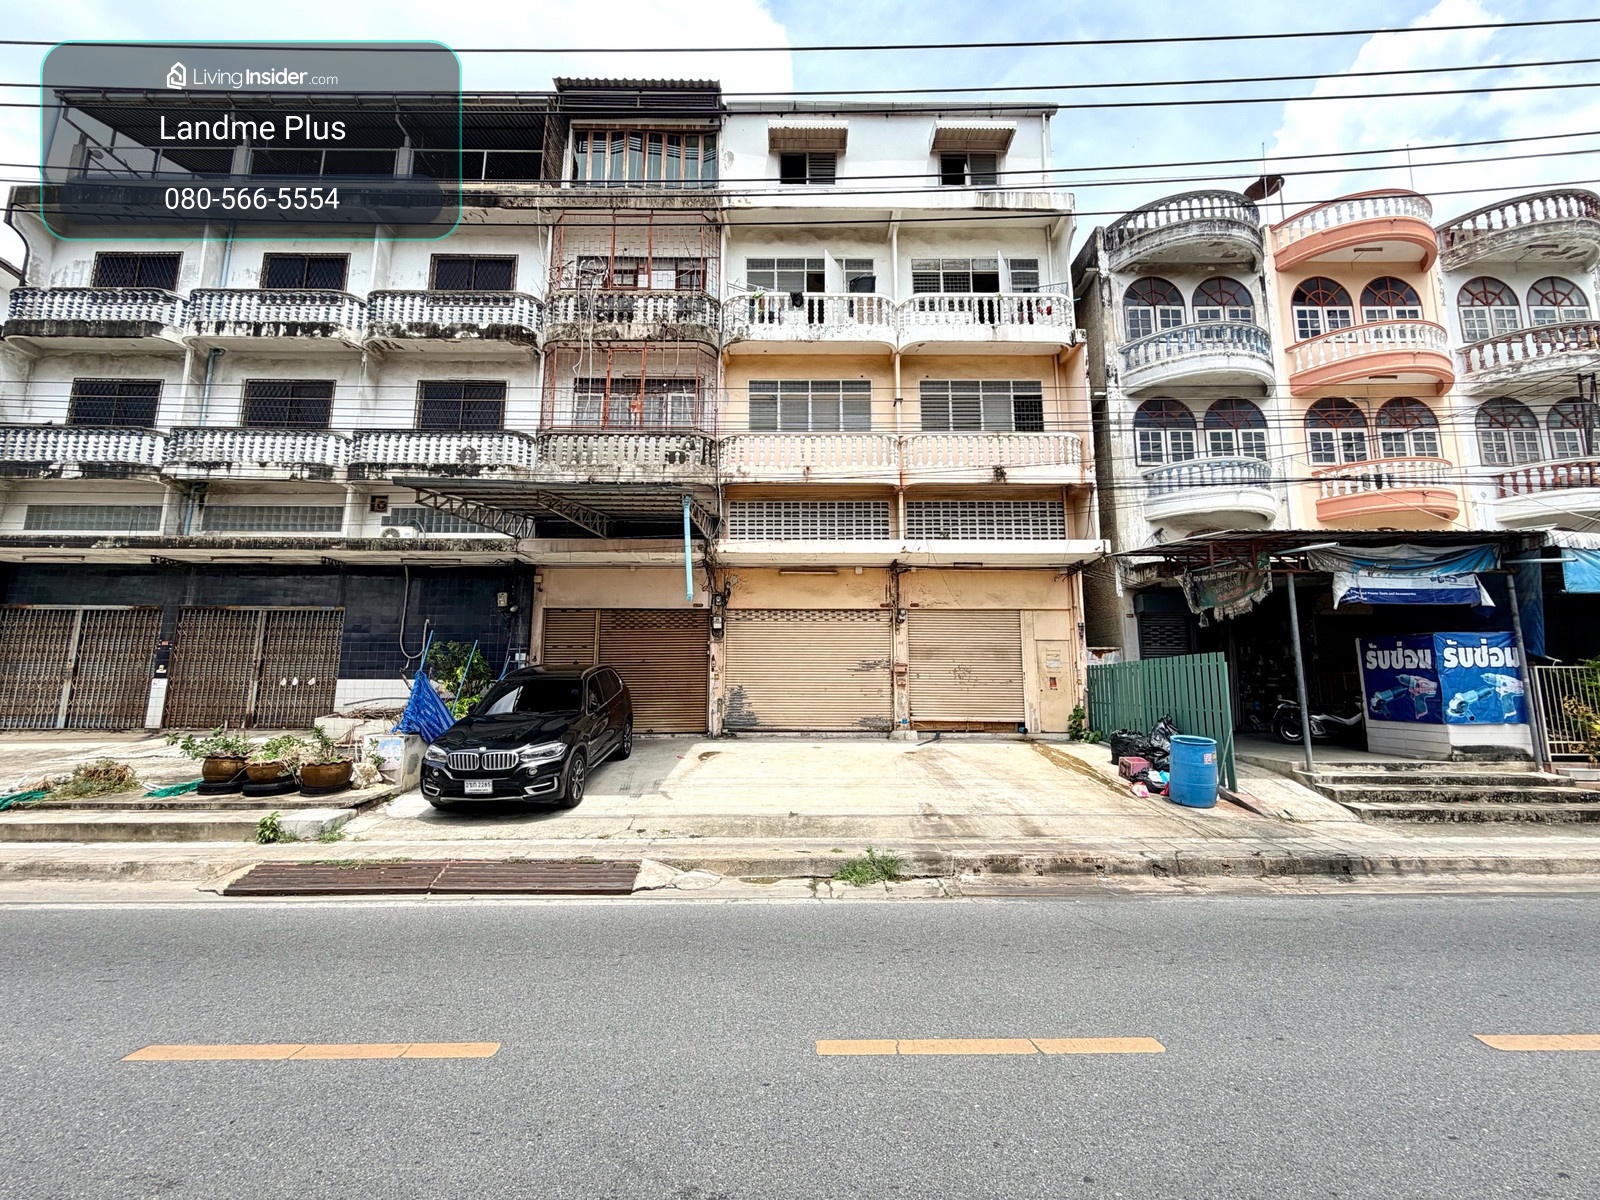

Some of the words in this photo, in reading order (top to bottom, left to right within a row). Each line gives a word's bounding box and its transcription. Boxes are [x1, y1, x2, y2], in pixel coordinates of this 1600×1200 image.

[1366, 641, 1432, 670] รับซ่อม
[1443, 638, 1520, 669] รับซ่อม
